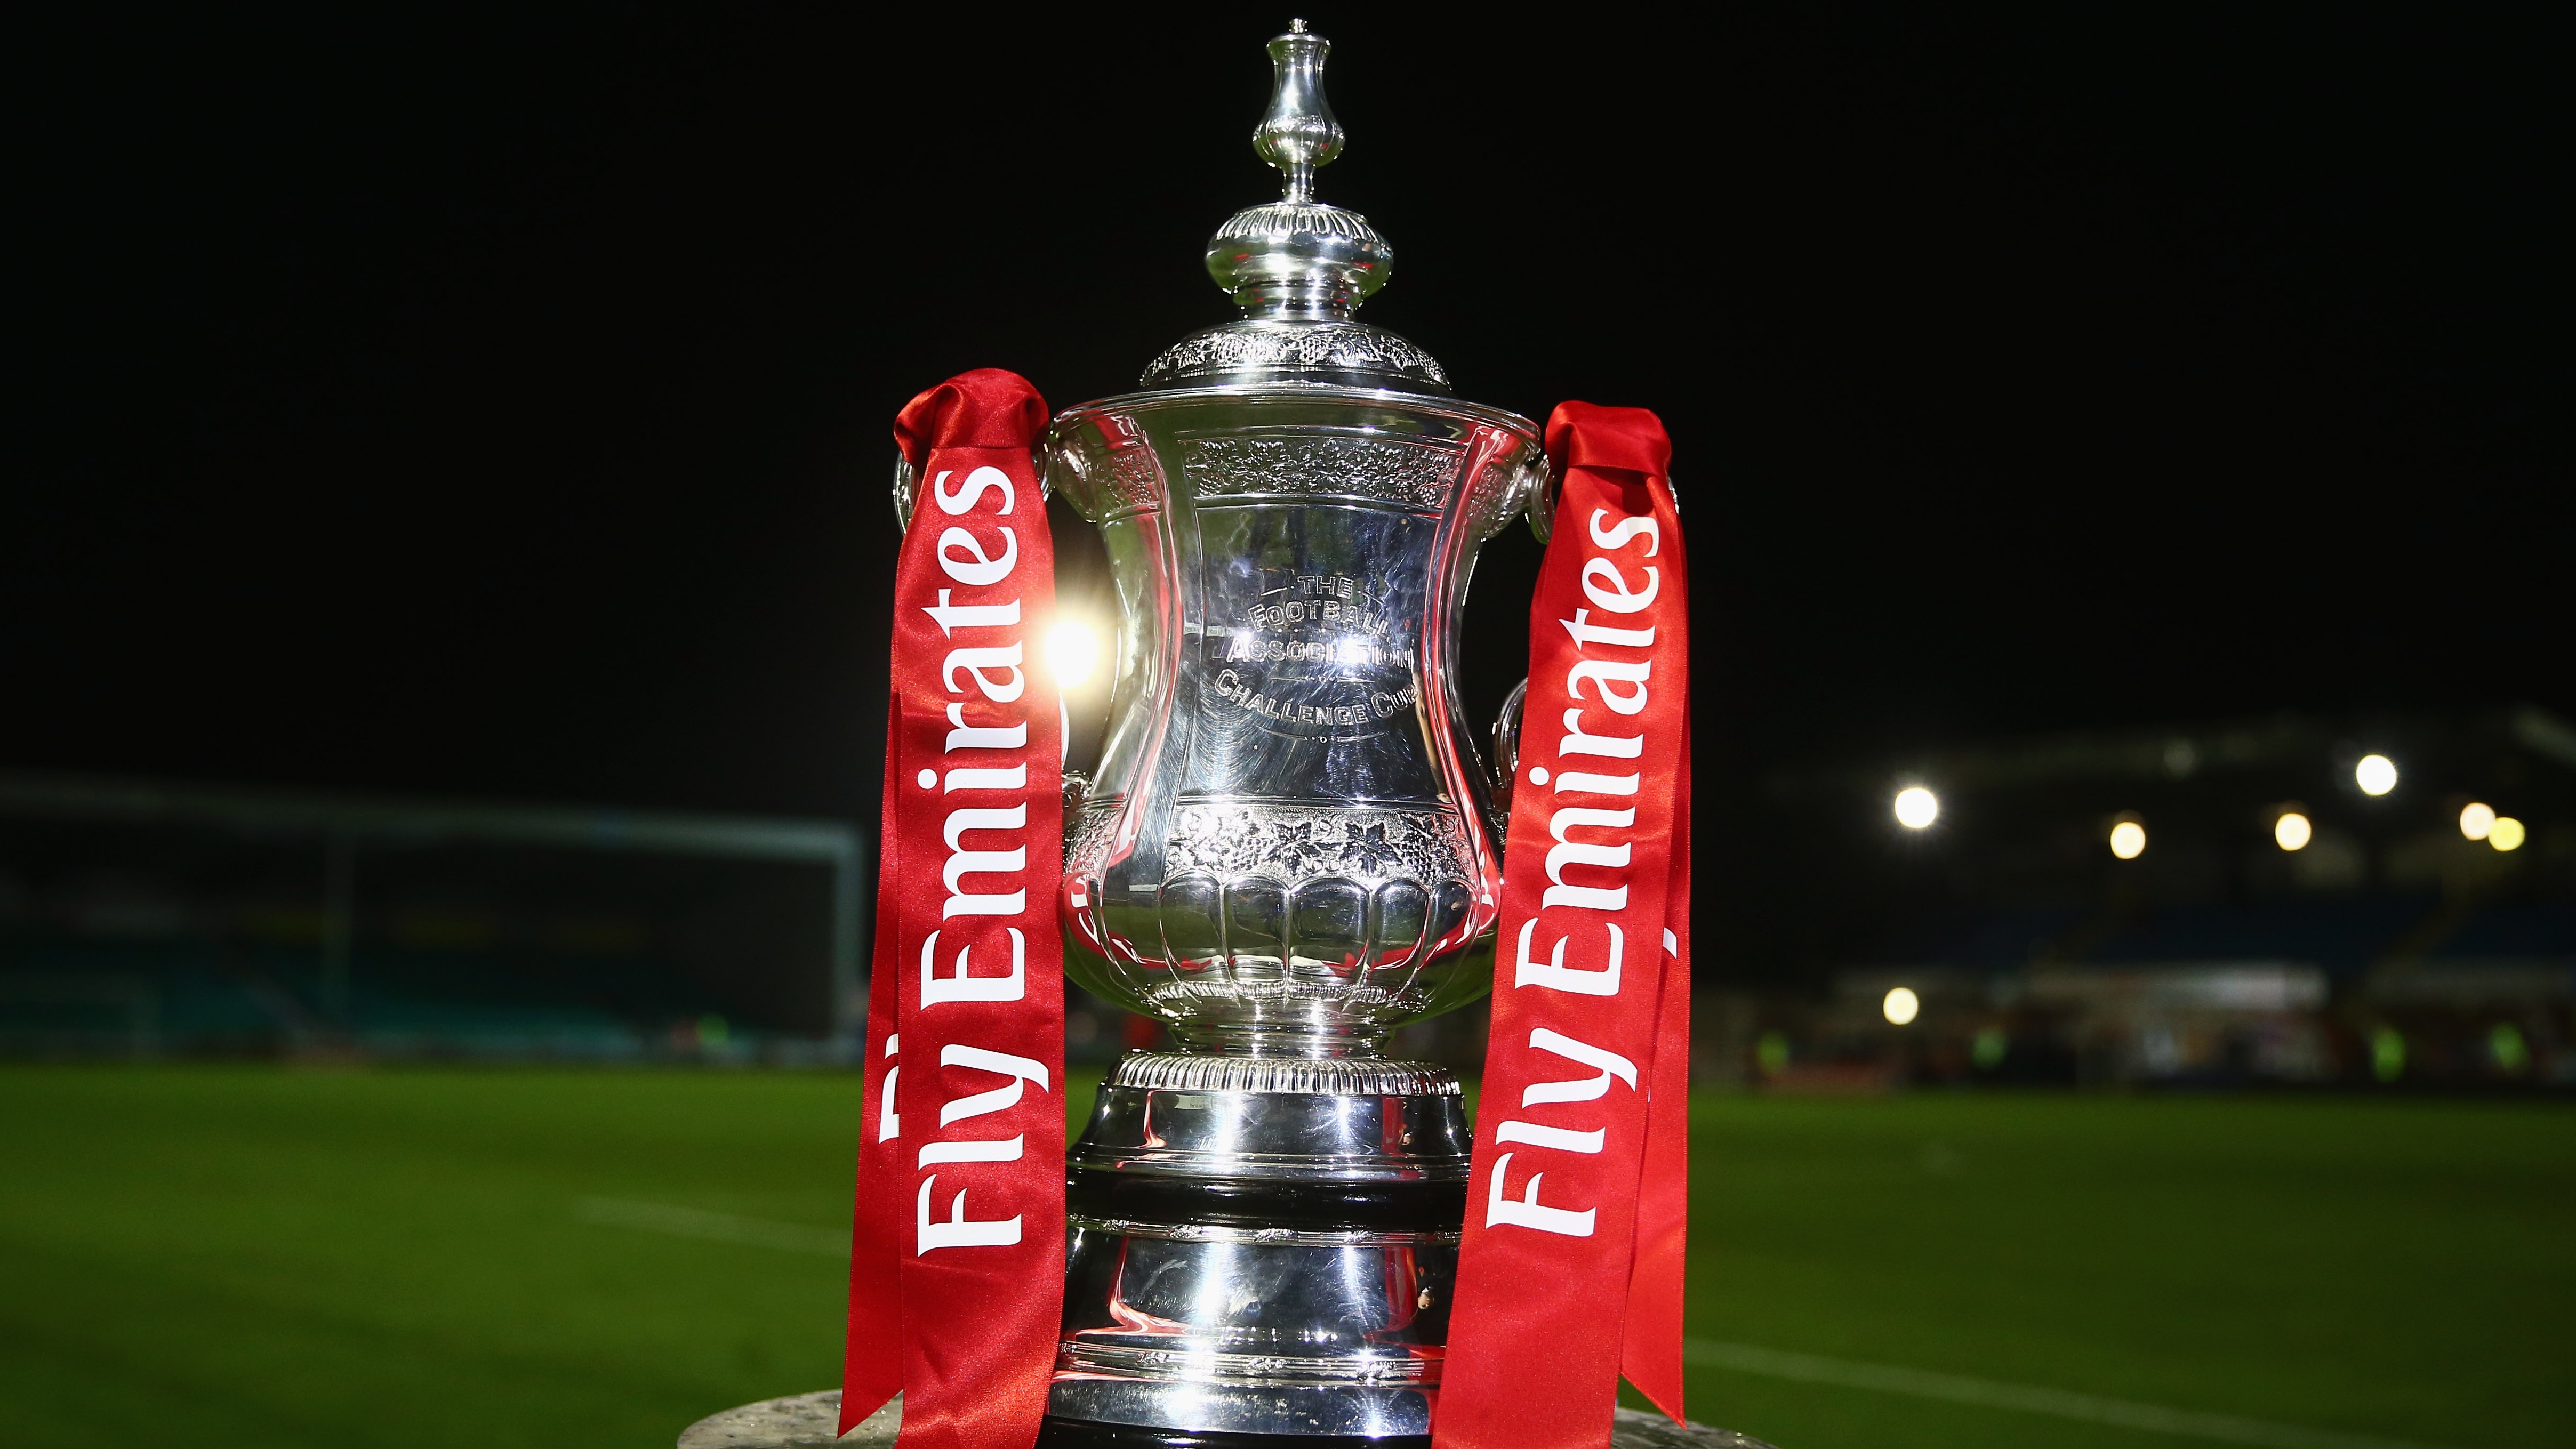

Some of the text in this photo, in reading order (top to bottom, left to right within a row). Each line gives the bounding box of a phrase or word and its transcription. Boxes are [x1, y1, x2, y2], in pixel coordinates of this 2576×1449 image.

[1297, 575, 1354, 599] THE
[1248, 599, 1390, 638] FOOTBALL
[1226, 636, 1415, 669] ASSOCITION
[1214, 669, 1367, 726] CHALLENGE
[917, 466, 1049, 1257] Fly Emirates
[1485, 508, 1660, 1237] Fly Emirates
